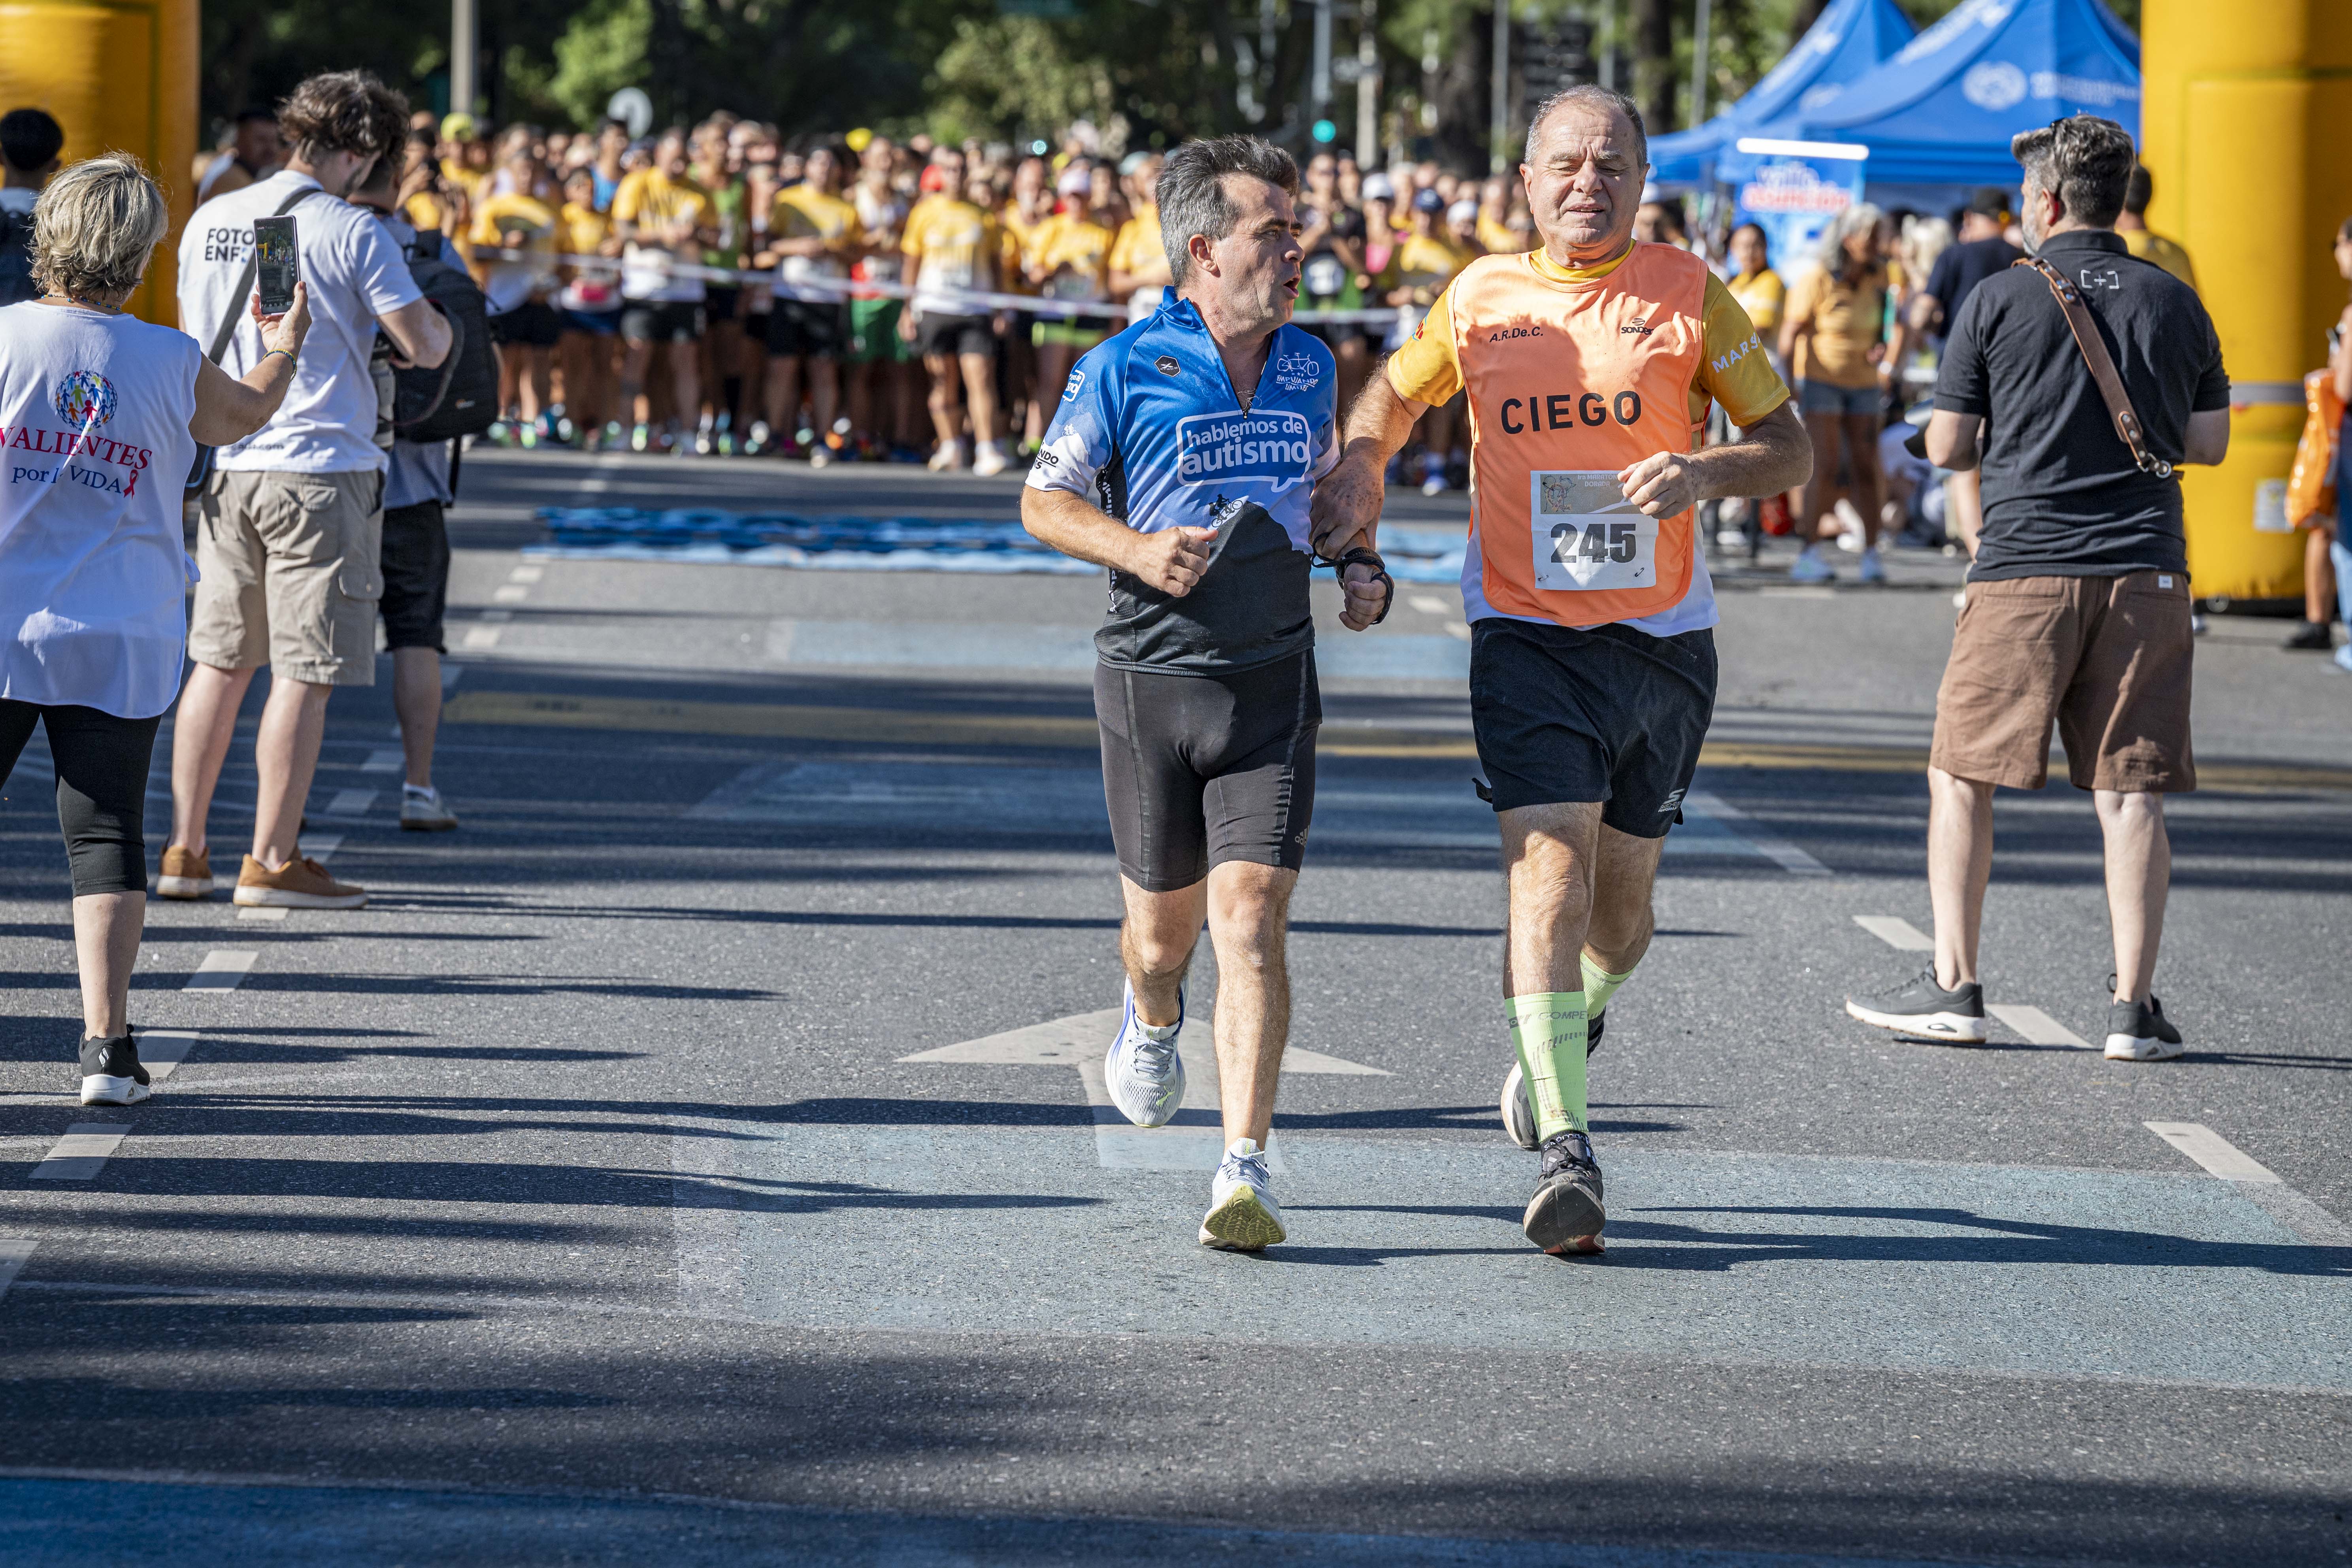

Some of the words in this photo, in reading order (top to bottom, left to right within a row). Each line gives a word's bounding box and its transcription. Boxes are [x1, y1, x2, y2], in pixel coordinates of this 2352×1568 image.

[1489, 326, 1543, 343] A.R.De.C.
[1712, 332, 1761, 373] MARS
[1277, 375, 1318, 385] EMPUJANDO
[1501, 391, 1641, 434] CIEGO
[0, 426, 152, 470] VALIENTES
[1187, 421, 1278, 448] hablemos
[1283, 416, 1303, 434] de
[1038, 449, 1059, 464] NDO
[1183, 436, 1309, 474] autismo
[11, 467, 49, 483] por
[70, 465, 121, 494] VIDA
[1551, 523, 1636, 563] 245
[1539, 1010, 1587, 1020] COMPE
